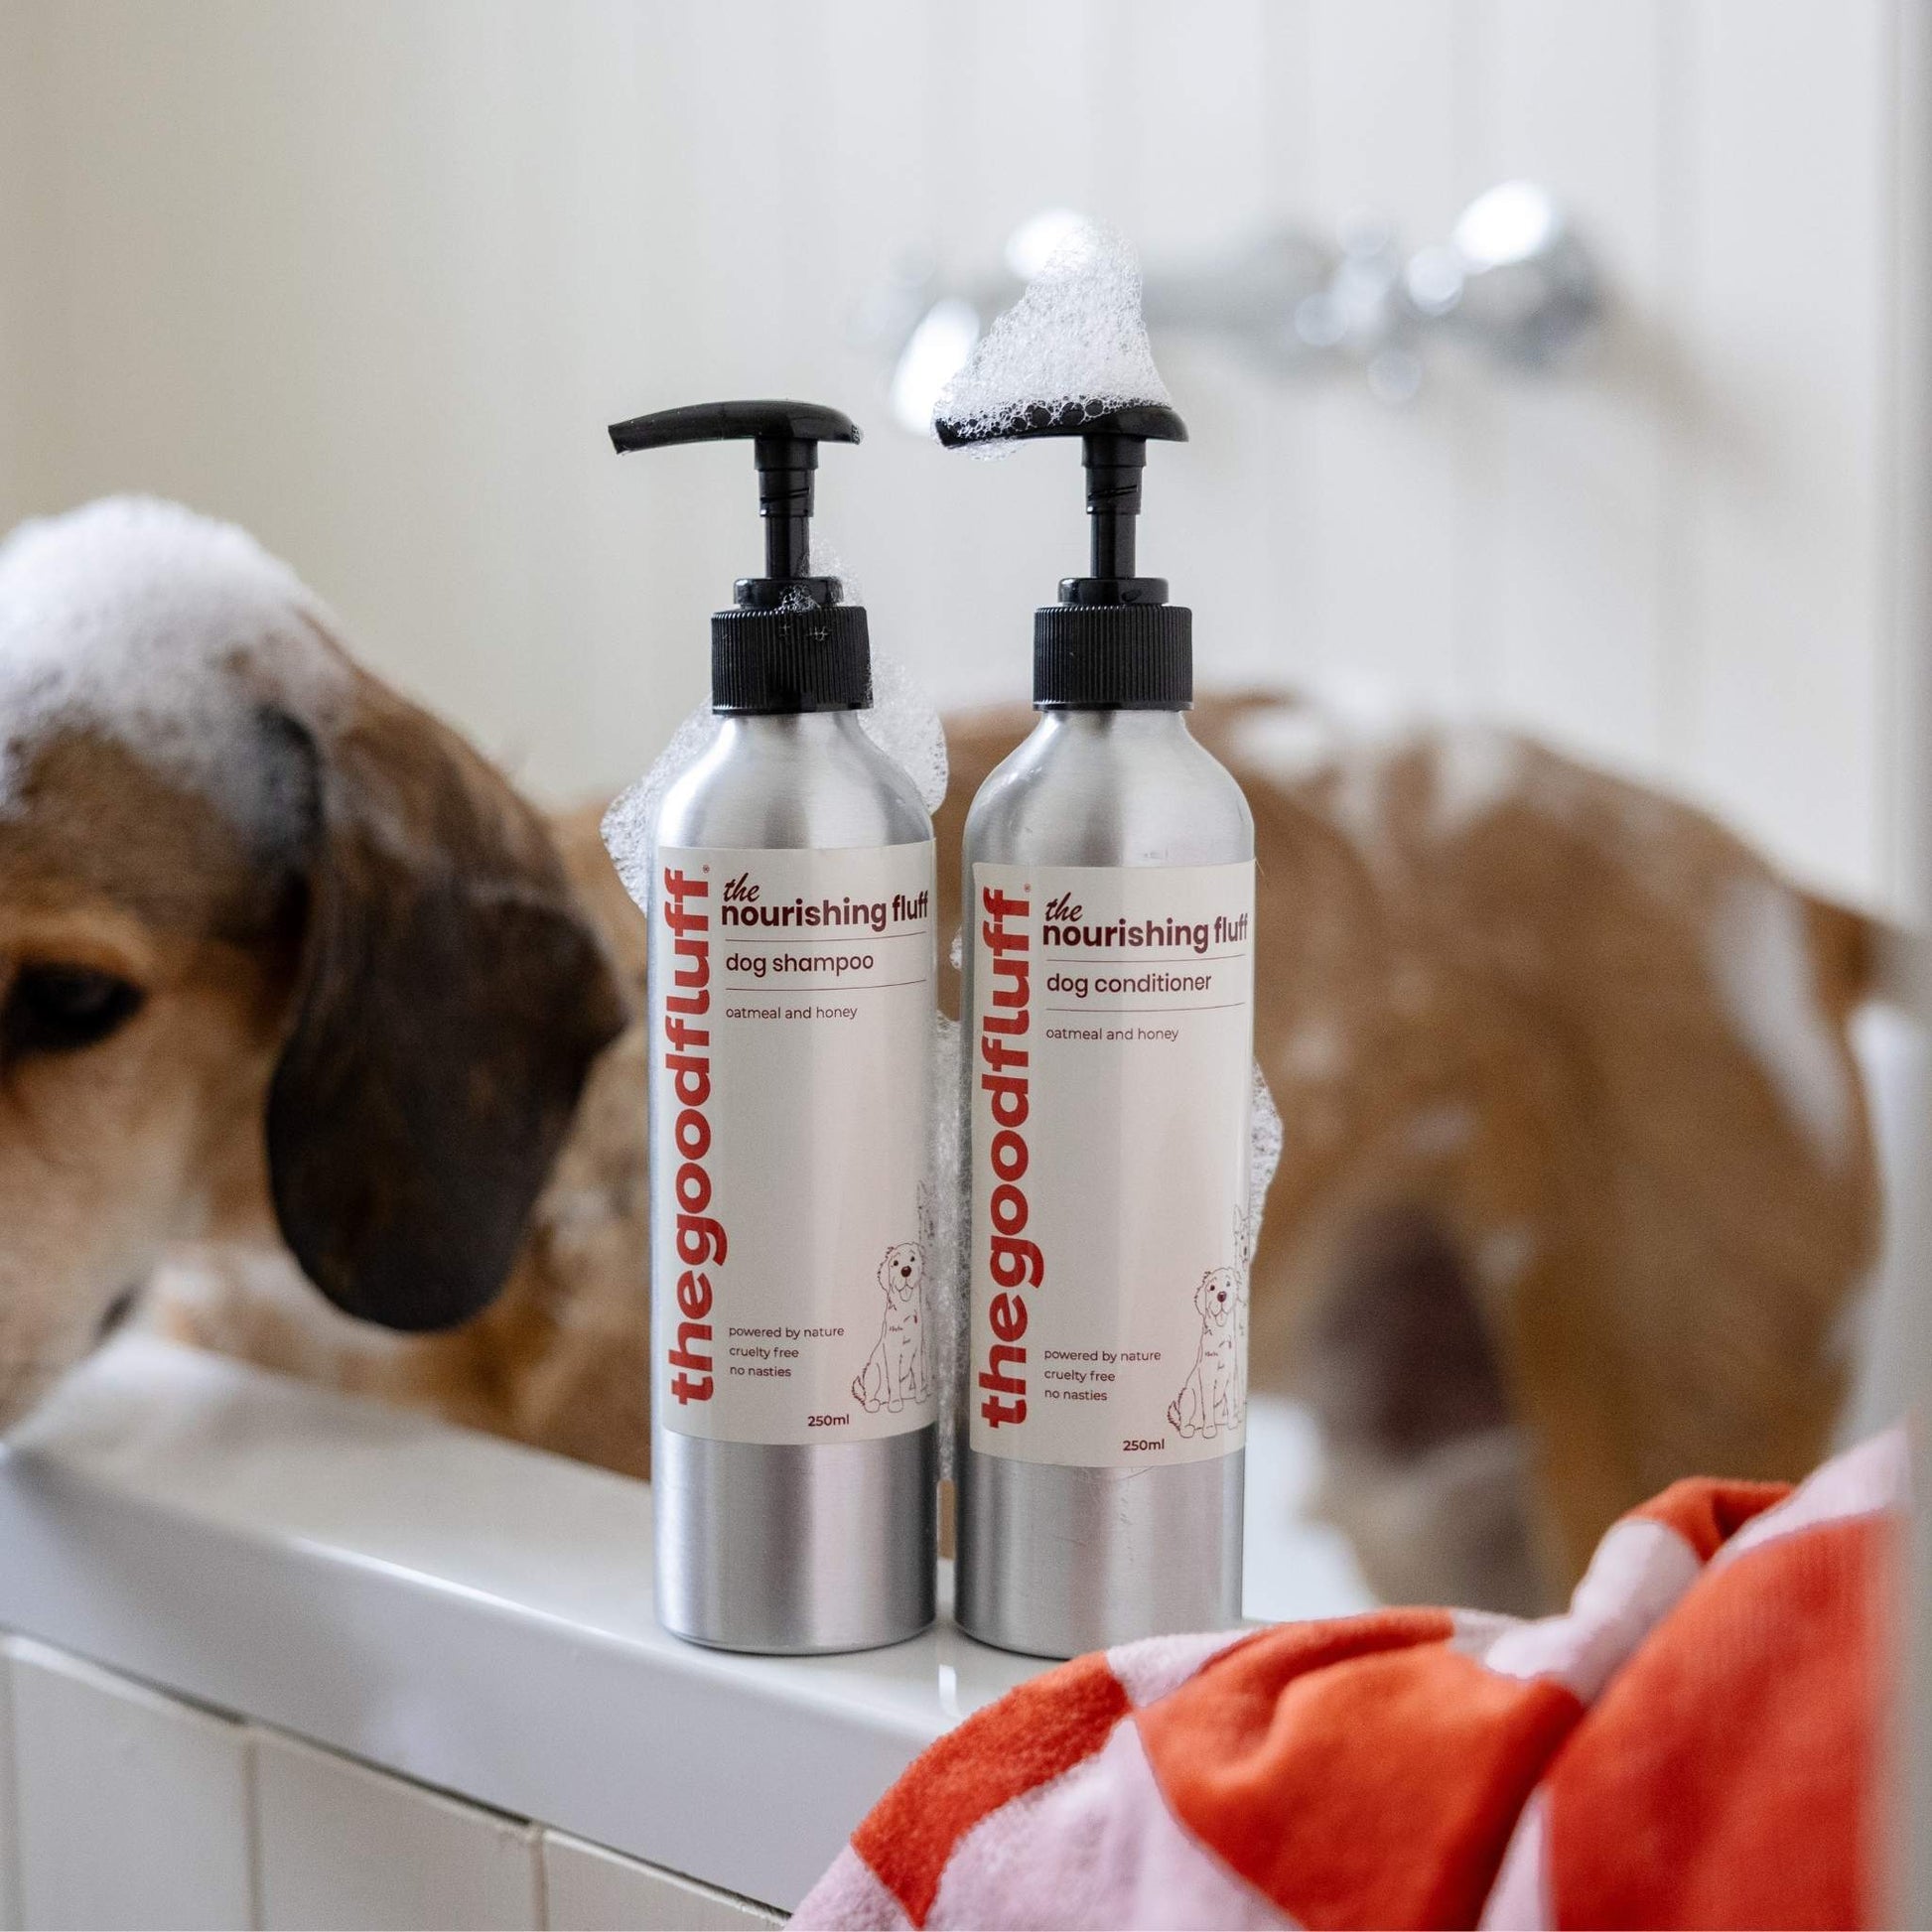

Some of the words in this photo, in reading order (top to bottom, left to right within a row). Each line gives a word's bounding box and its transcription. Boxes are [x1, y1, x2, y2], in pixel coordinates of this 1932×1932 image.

[723, 873, 760, 902] the
[721, 898, 887, 932] nourishing
[893, 890, 929, 922] fluff
[1044, 893, 1083, 922] the
[1042, 918, 1209, 954] nourishing
[1214, 913, 1248, 943] fluff
[726, 953, 766, 978] dog
[772, 953, 875, 976] shampoo
[1046, 973, 1088, 998] dog
[1094, 973, 1212, 993] conditioner
[726, 1007, 781, 1020] oatmeal
[785, 1007, 812, 1020] and
[816, 1007, 858, 1021] honey
[1045, 1027, 1103, 1040] oatmeal
[1106, 1028, 1133, 1040] and
[1138, 1028, 1179, 1041] honey
[664, 867, 728, 1405] thegoodfluff
[979, 887, 1044, 1429] thegoodfluff
[729, 1326, 782, 1338] powered
[785, 1327, 800, 1340] by
[803, 1326, 845, 1337] nature
[729, 1346, 769, 1359] cruelty
[773, 1346, 799, 1358] free
[1044, 1350, 1098, 1362] powered
[1102, 1350, 1118, 1363] by
[1120, 1350, 1162, 1361] nature
[730, 1365, 745, 1376] no
[748, 1365, 792, 1377] nasties
[1044, 1369, 1087, 1383] cruelty
[1090, 1370, 1116, 1382] free
[1044, 1389, 1060, 1400] no
[1063, 1389, 1108, 1402] nasties
[807, 1414, 850, 1427] 250ml
[1123, 1439, 1166, 1451] 250ml
